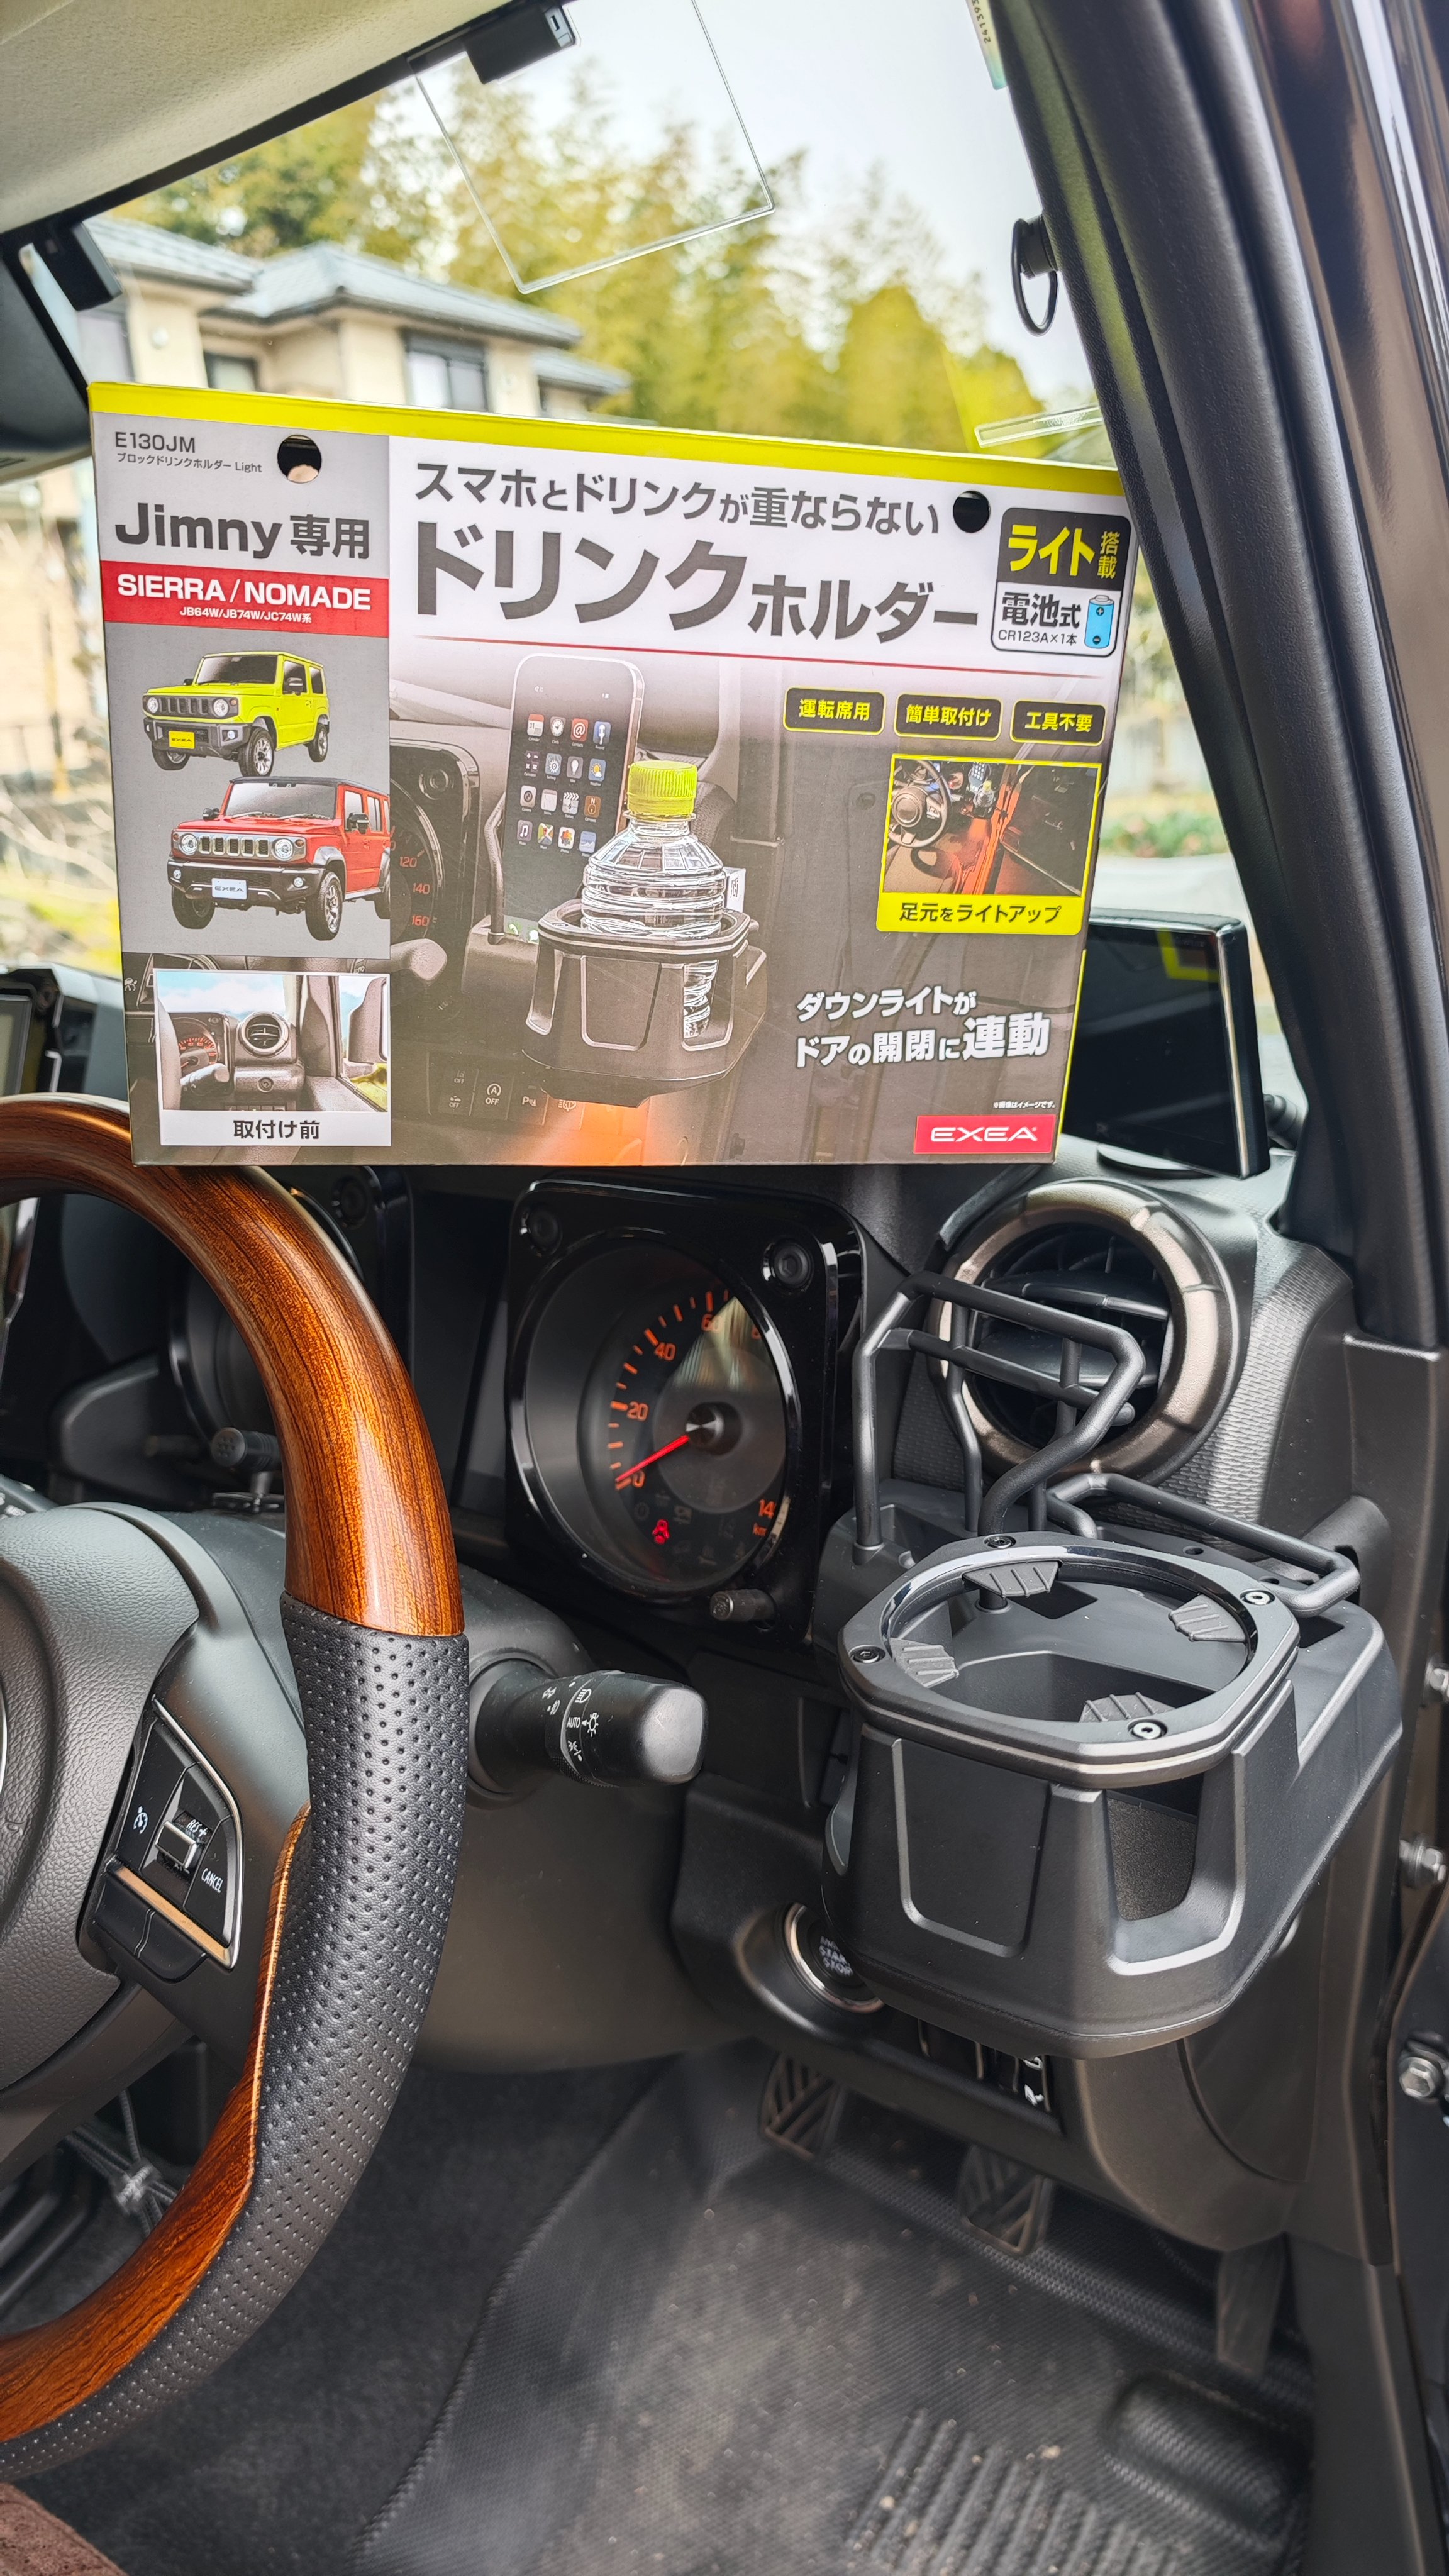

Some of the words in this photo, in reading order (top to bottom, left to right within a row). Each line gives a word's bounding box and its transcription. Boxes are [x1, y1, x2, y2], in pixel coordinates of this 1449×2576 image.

[116, 431, 196, 453] E130JM
[117, 453, 231, 470] ブロックドリンクホルダー
[235, 461, 262, 473] Light
[415, 462, 940, 536] スマホとドリンクが重ならない
[418, 521, 979, 644] ドリンクホルダー
[179, 606, 313, 625] JB64W/JB74W/JC74W系
[1001, 591, 1082, 629] 電池式
[798, 698, 871, 721] 運転席用
[905, 704, 992, 727] 簡単取付け
[1024, 711, 1094, 733] 工具不要
[399, 856, 418, 868] 120
[413, 882, 431, 894] 140
[412, 914, 430, 927] 160
[898, 902, 1062, 924] 足元をライトアップ
[796, 985, 978, 1022] ダウンライトが
[796, 1011, 1052, 1068] ドアの開閉に連動
[485, 1097, 500, 1106] OFF
[233, 1119, 321, 1140] 取付け前
[931, 1126, 1038, 1142] EXEA
[701, 1313, 723, 1333] 60
[653, 1341, 676, 1361] 40
[626, 1401, 649, 1421] 20
[567, 1716, 581, 1728] AUTO
[201, 1868, 224, 1894] CANCEL
[819, 1945, 851, 1967] STAR
